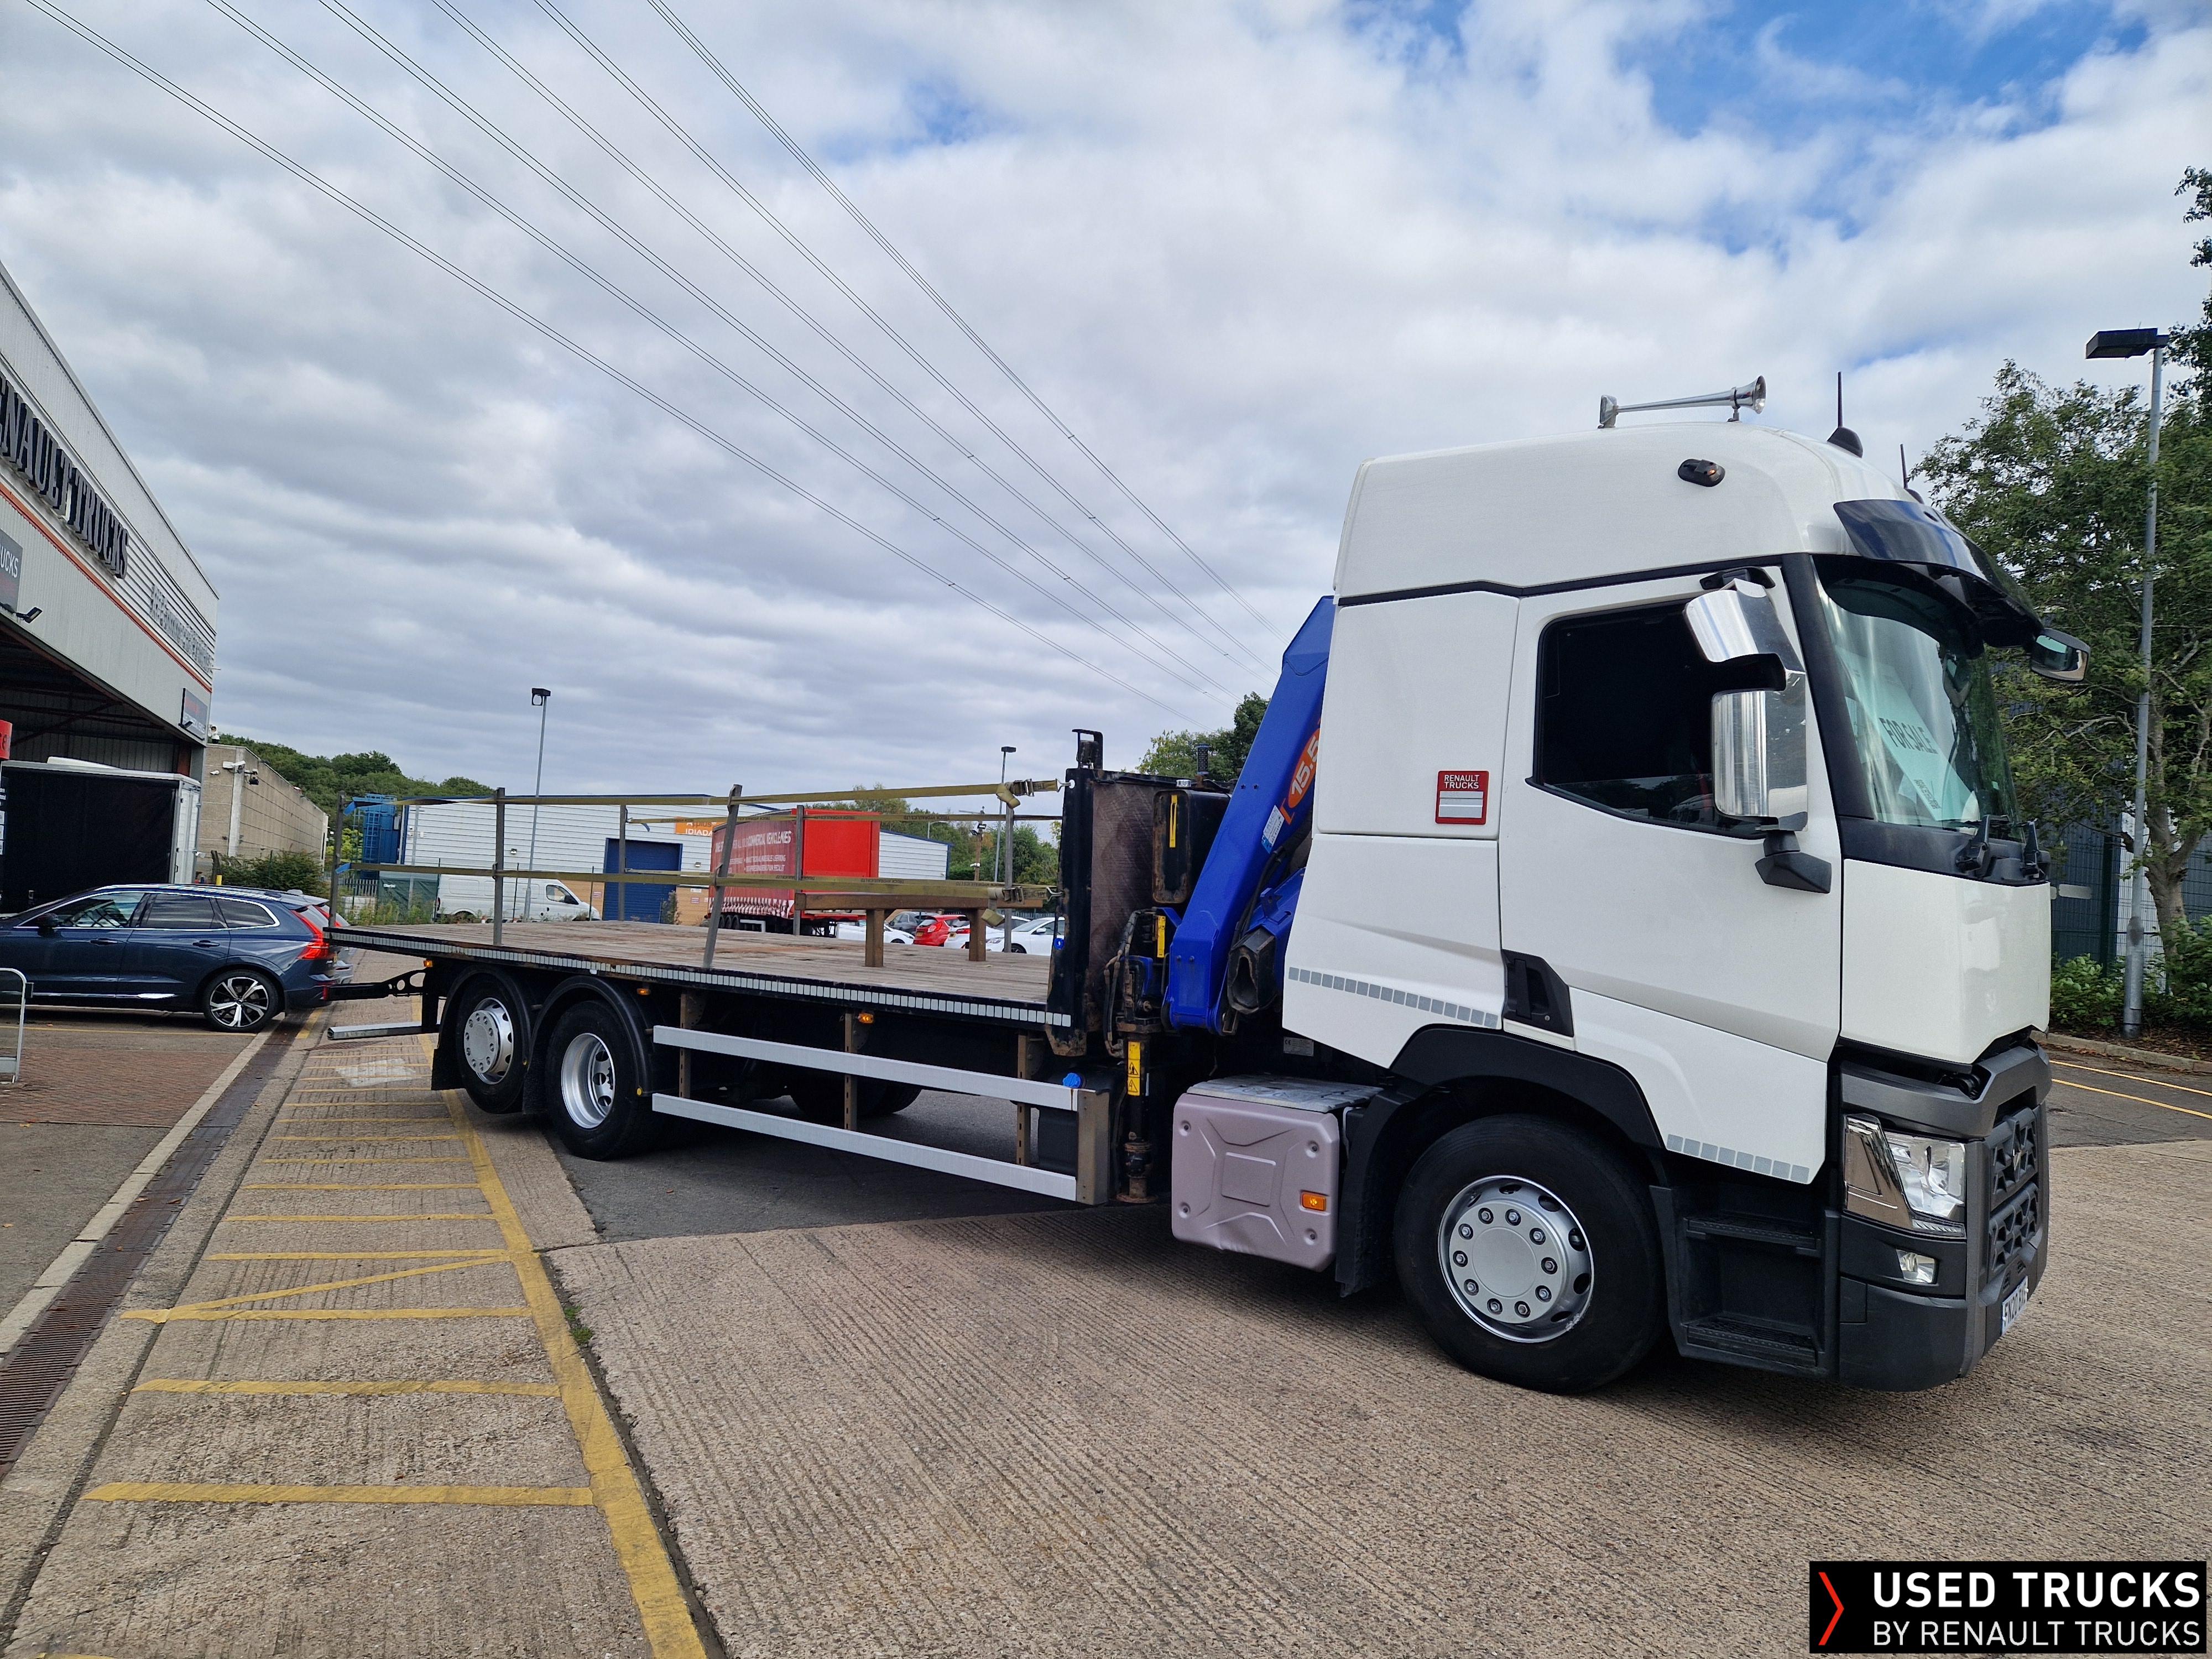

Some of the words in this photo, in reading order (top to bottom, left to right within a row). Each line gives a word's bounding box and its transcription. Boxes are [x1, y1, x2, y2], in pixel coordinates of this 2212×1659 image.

[67, 467, 128, 579] TRUCKS
[1879, 717, 1915, 750] FOR
[1901, 722, 1939, 754] SALE
[686, 828, 713, 836] IDIADA
